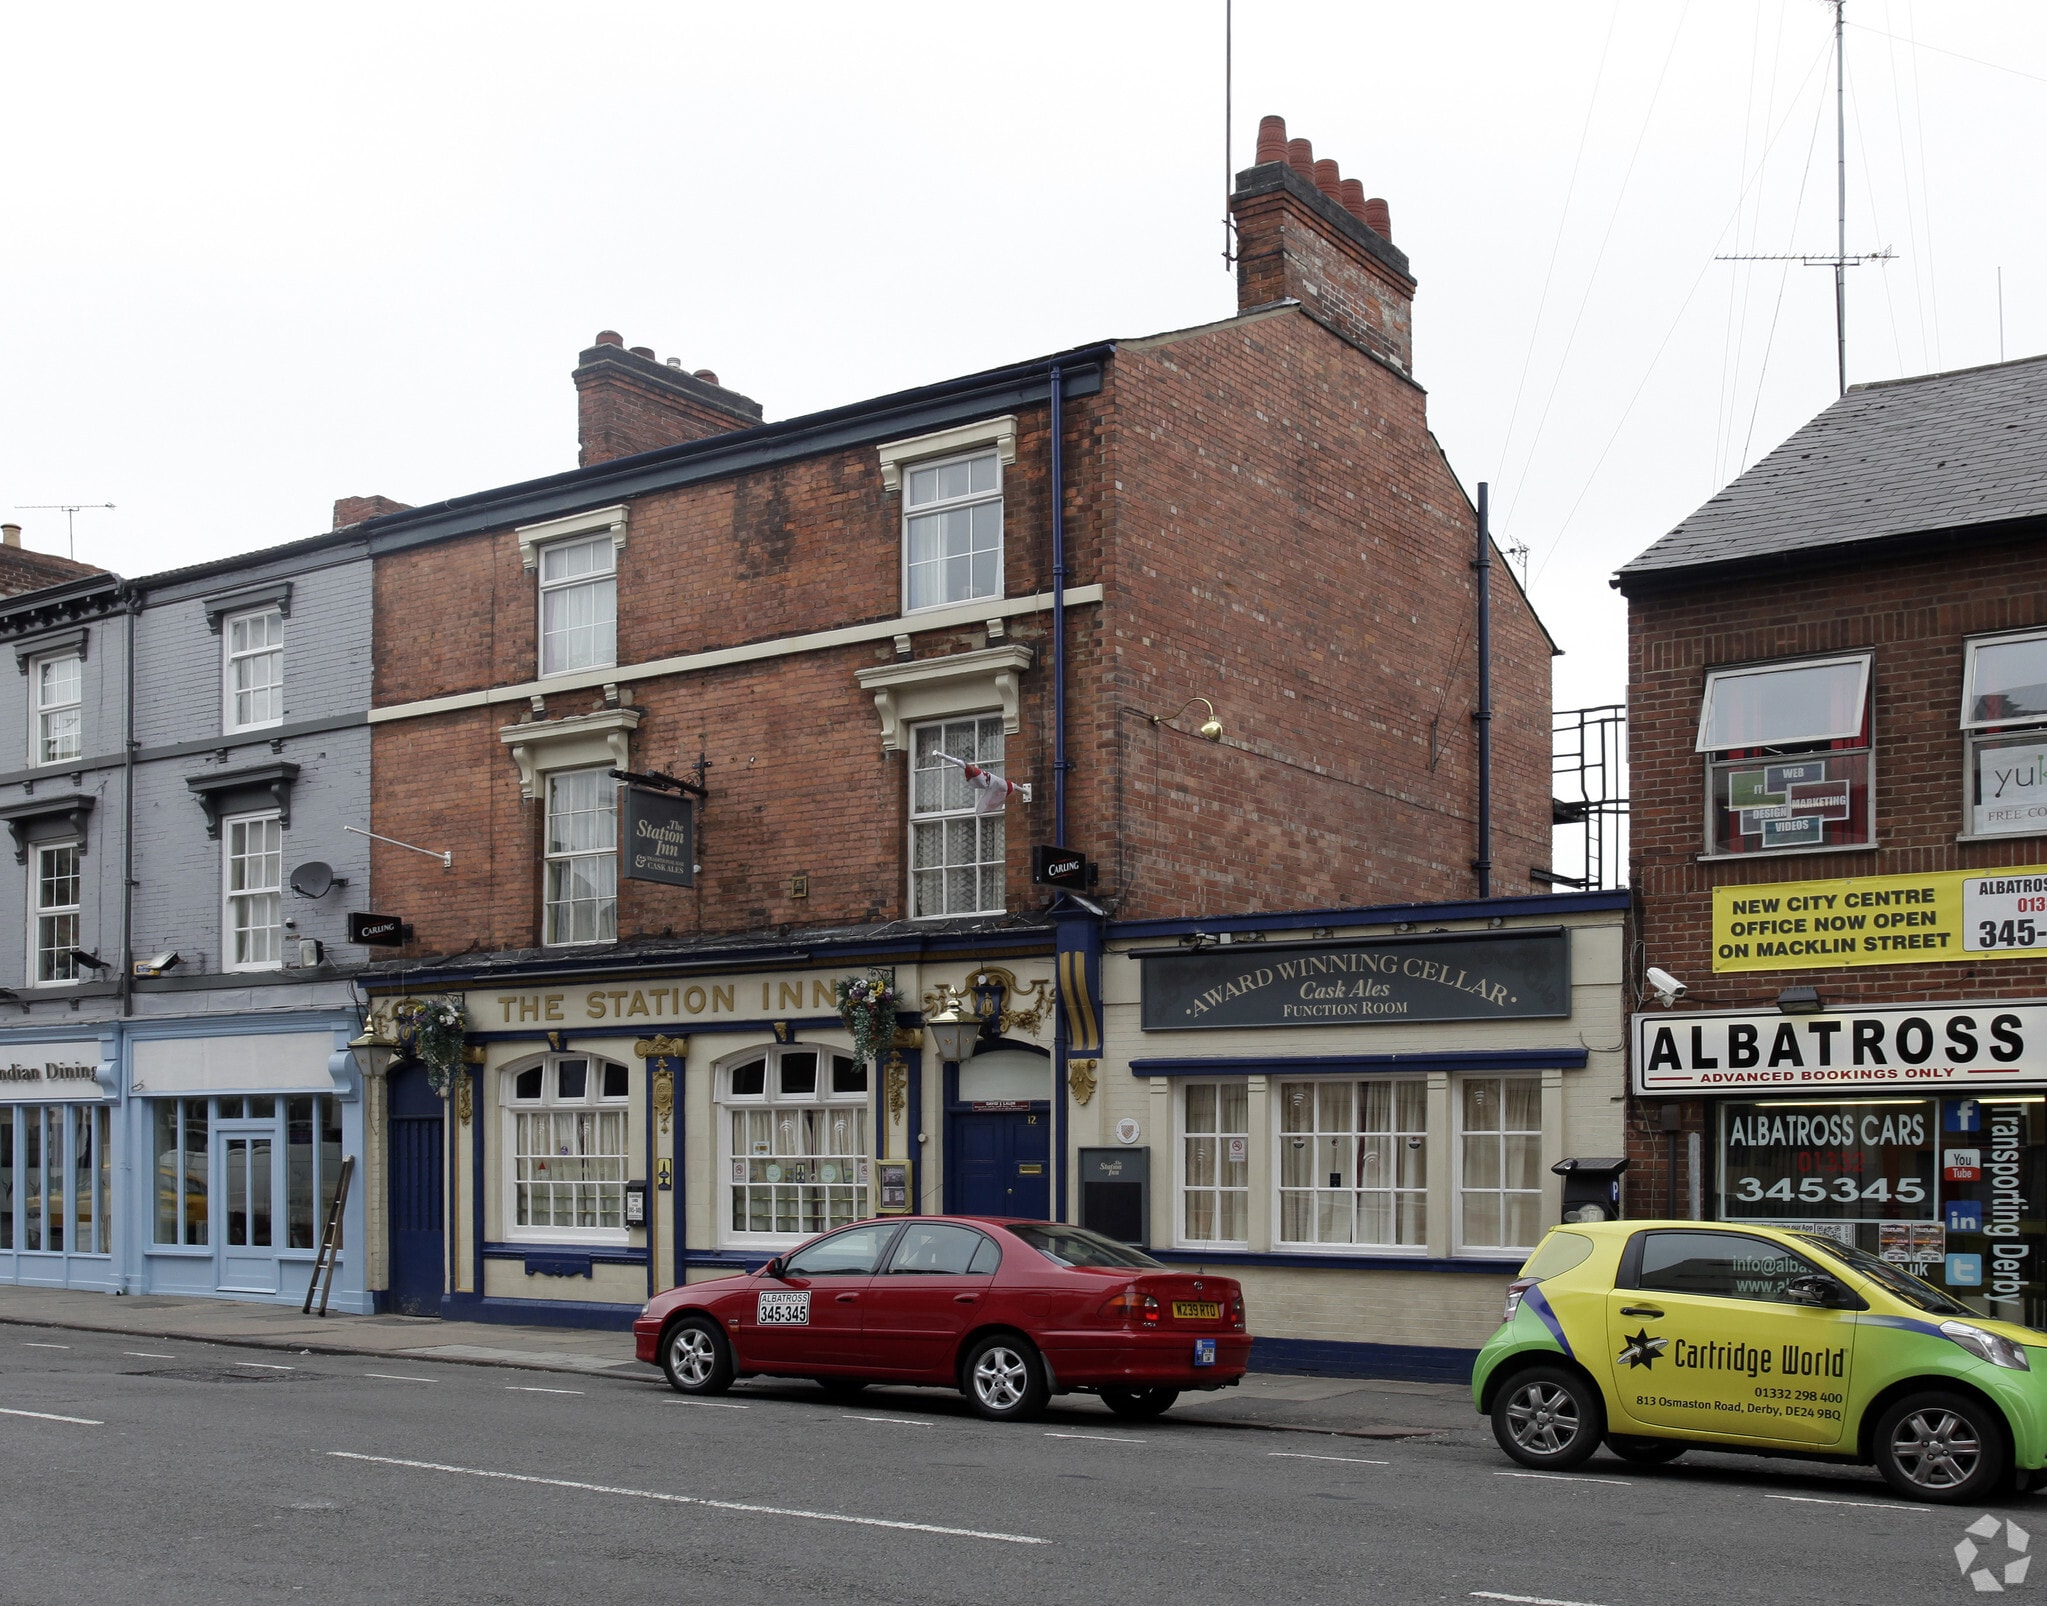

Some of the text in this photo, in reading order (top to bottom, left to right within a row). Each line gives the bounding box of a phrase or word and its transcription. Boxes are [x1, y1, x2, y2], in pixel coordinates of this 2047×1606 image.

[1782, 768, 1804, 779] WEB
[1753, 784, 1763, 795] IT
[1791, 795, 1846, 808] MARKETING
[1753, 807, 1786, 819] DESIGN
[1988, 809, 2022, 821] FREE
[636, 819, 684, 844] Station
[670, 820, 684, 832] The
[1775, 819, 1809, 832] VIDEOS
[655, 840, 678, 857] Inn
[635, 854, 646, 868] &
[647, 861, 684, 874] CASK ALES
[1048, 860, 1079, 876] CARLING
[1732, 888, 1935, 915] NEW CITY CENTRE
[361, 923, 395, 937] CARLING
[1730, 911, 1936, 937] OFFICE NOW OPEN
[1718, 932, 1951, 959] ON MACKLIN STREET
[1192, 954, 1508, 1018] AWARD WINNING CELLAR
[1300, 978, 1390, 999] Cask Ales
[497, 979, 837, 1022] THE STATION INN
[1283, 1001, 1408, 1018] FUNCTION ROOM
[1648, 1013, 2024, 1071] ALBATROSS
[1700, 1066, 1955, 1083] ADVANCED BOOKINGS ONLY
[1027, 1115, 1037, 1124] 12
[1729, 1113, 1925, 1147] ALBATROSS CARS
[1100, 1162, 1122, 1170] Station
[1797, 1151, 1865, 1173] 01332
[1953, 1153, 1971, 1166] You
[1952, 1168, 1972, 1178] Tube
[1736, 1177, 1926, 1203] 345345
[1983, 1104, 2029, 1305] Transporting Derby
[1951, 1211, 1976, 1229] in
[1732, 1255, 1813, 1277] info@alba
[762, 1294, 808, 1303] ALBATROSS
[760, 1306, 806, 1322] 345-345
[1200, 1304, 1216, 1317] RTO
[1675, 1339, 1844, 1378] Cartridge World
[1754, 1387, 1843, 1403] 01332 298 400
[1636, 1395, 1842, 1422] 813 Osmaston Road, Derby, DE24 9BQ
